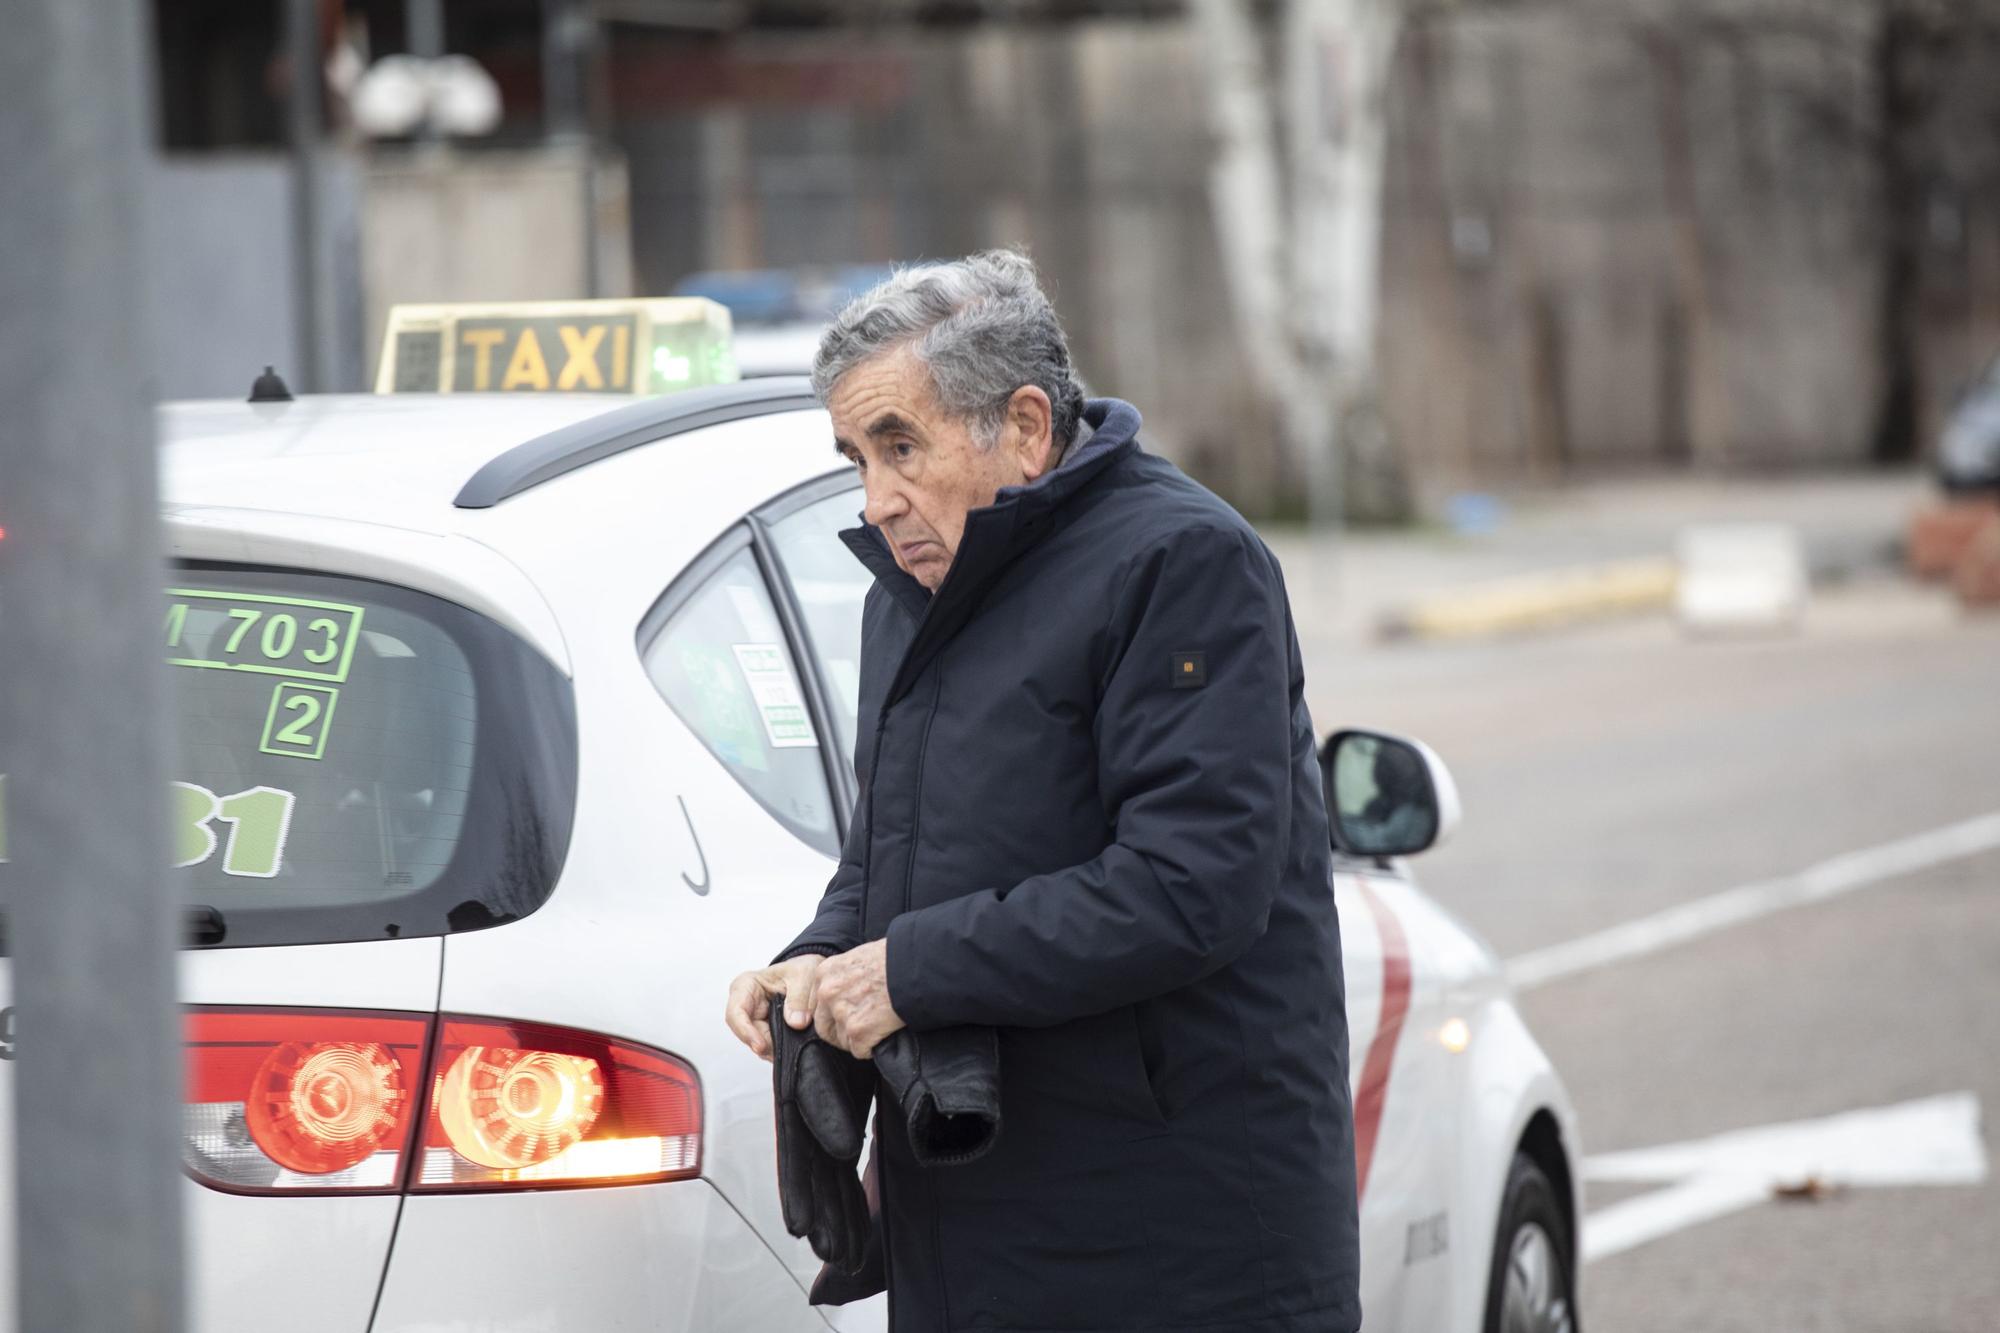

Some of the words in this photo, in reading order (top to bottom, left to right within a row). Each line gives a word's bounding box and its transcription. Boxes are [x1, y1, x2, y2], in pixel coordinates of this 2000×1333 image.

[462, 324, 631, 391] TAXI
[224, 607, 341, 664] 703
[275, 694, 322, 746] 2
